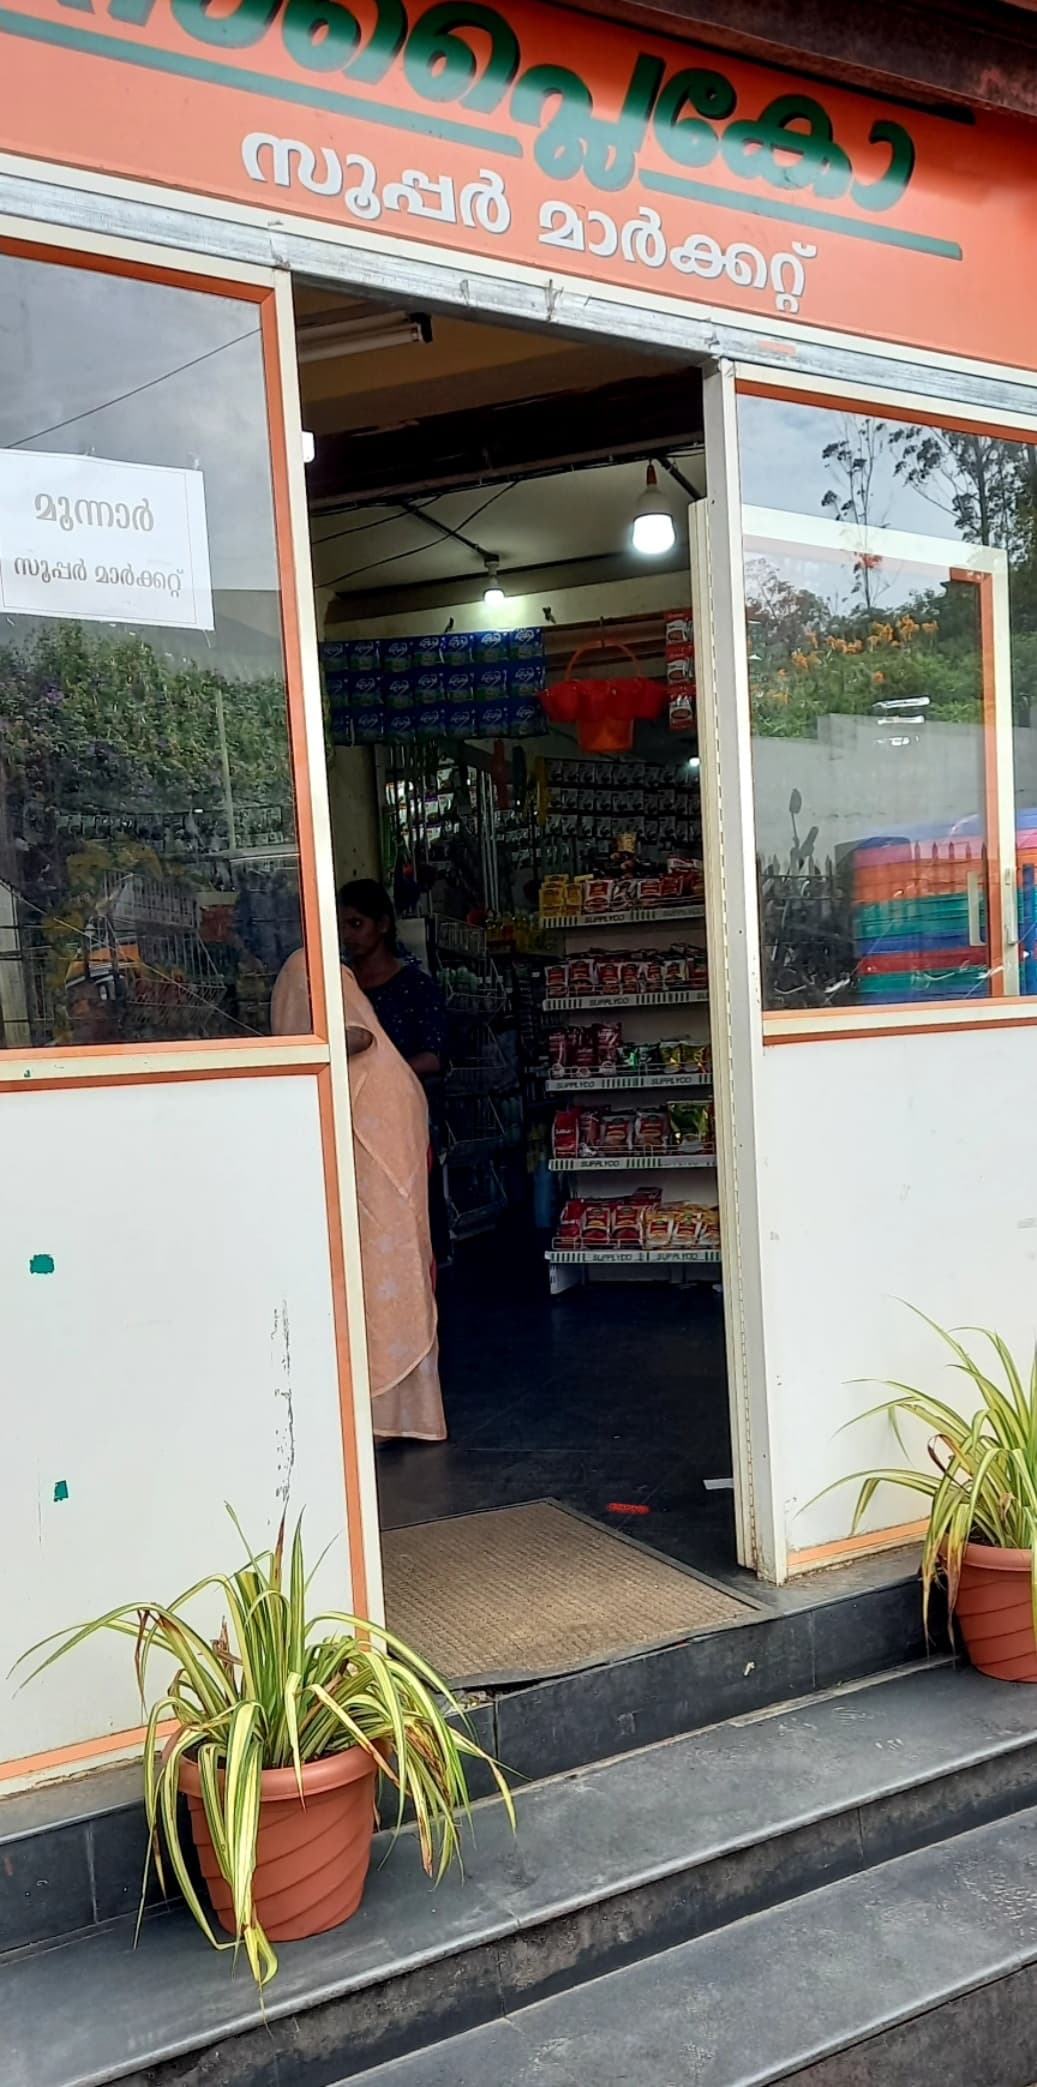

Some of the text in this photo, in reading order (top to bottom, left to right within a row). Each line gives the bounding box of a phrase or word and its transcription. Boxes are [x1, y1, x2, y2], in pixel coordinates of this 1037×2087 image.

[240, 131, 817, 314] സൂപ്പർ മാർക്കറ്റ്
[34, 492, 154, 532] മൂന്നാർ
[14, 556, 184, 598] സൂപ്പർ മാർക്കറ്റ്
[584, 913, 625, 923] SUPPLYCO
[589, 996, 630, 1007] SUPPLYCO
[556, 1075, 692, 1089] SUPPLYCO SUPPLYCO
[580, 1159, 620, 1168] SUPPLYCO
[592, 1253, 633, 1262] SUPPLYCO
